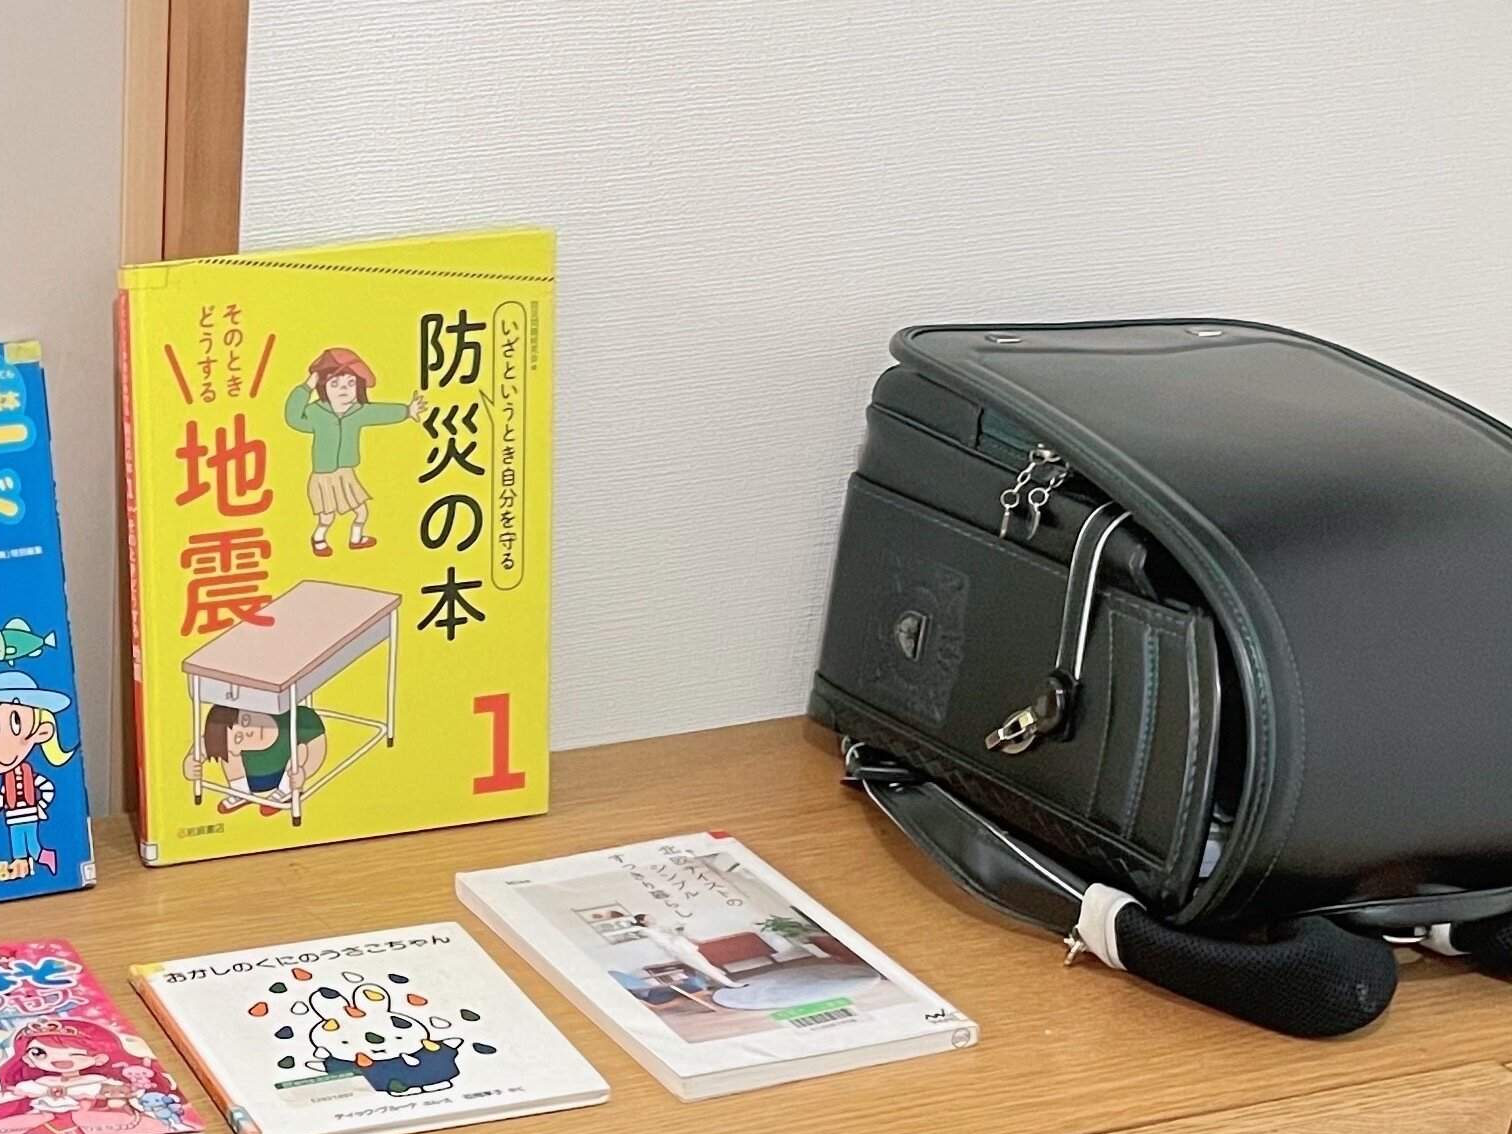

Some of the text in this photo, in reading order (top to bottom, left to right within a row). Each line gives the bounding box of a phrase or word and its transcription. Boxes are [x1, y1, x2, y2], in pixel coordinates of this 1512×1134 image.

[196, 305, 218, 403] どうする
[222, 303, 243, 398] そのとき
[416, 309, 488, 642] 防災の本
[498, 318, 520, 571] いざというとき自分を守る
[175, 412, 276, 637] 地震
[472, 692, 527, 795] 1
[164, 932, 452, 985] おかしのくにのうさこちゃん
